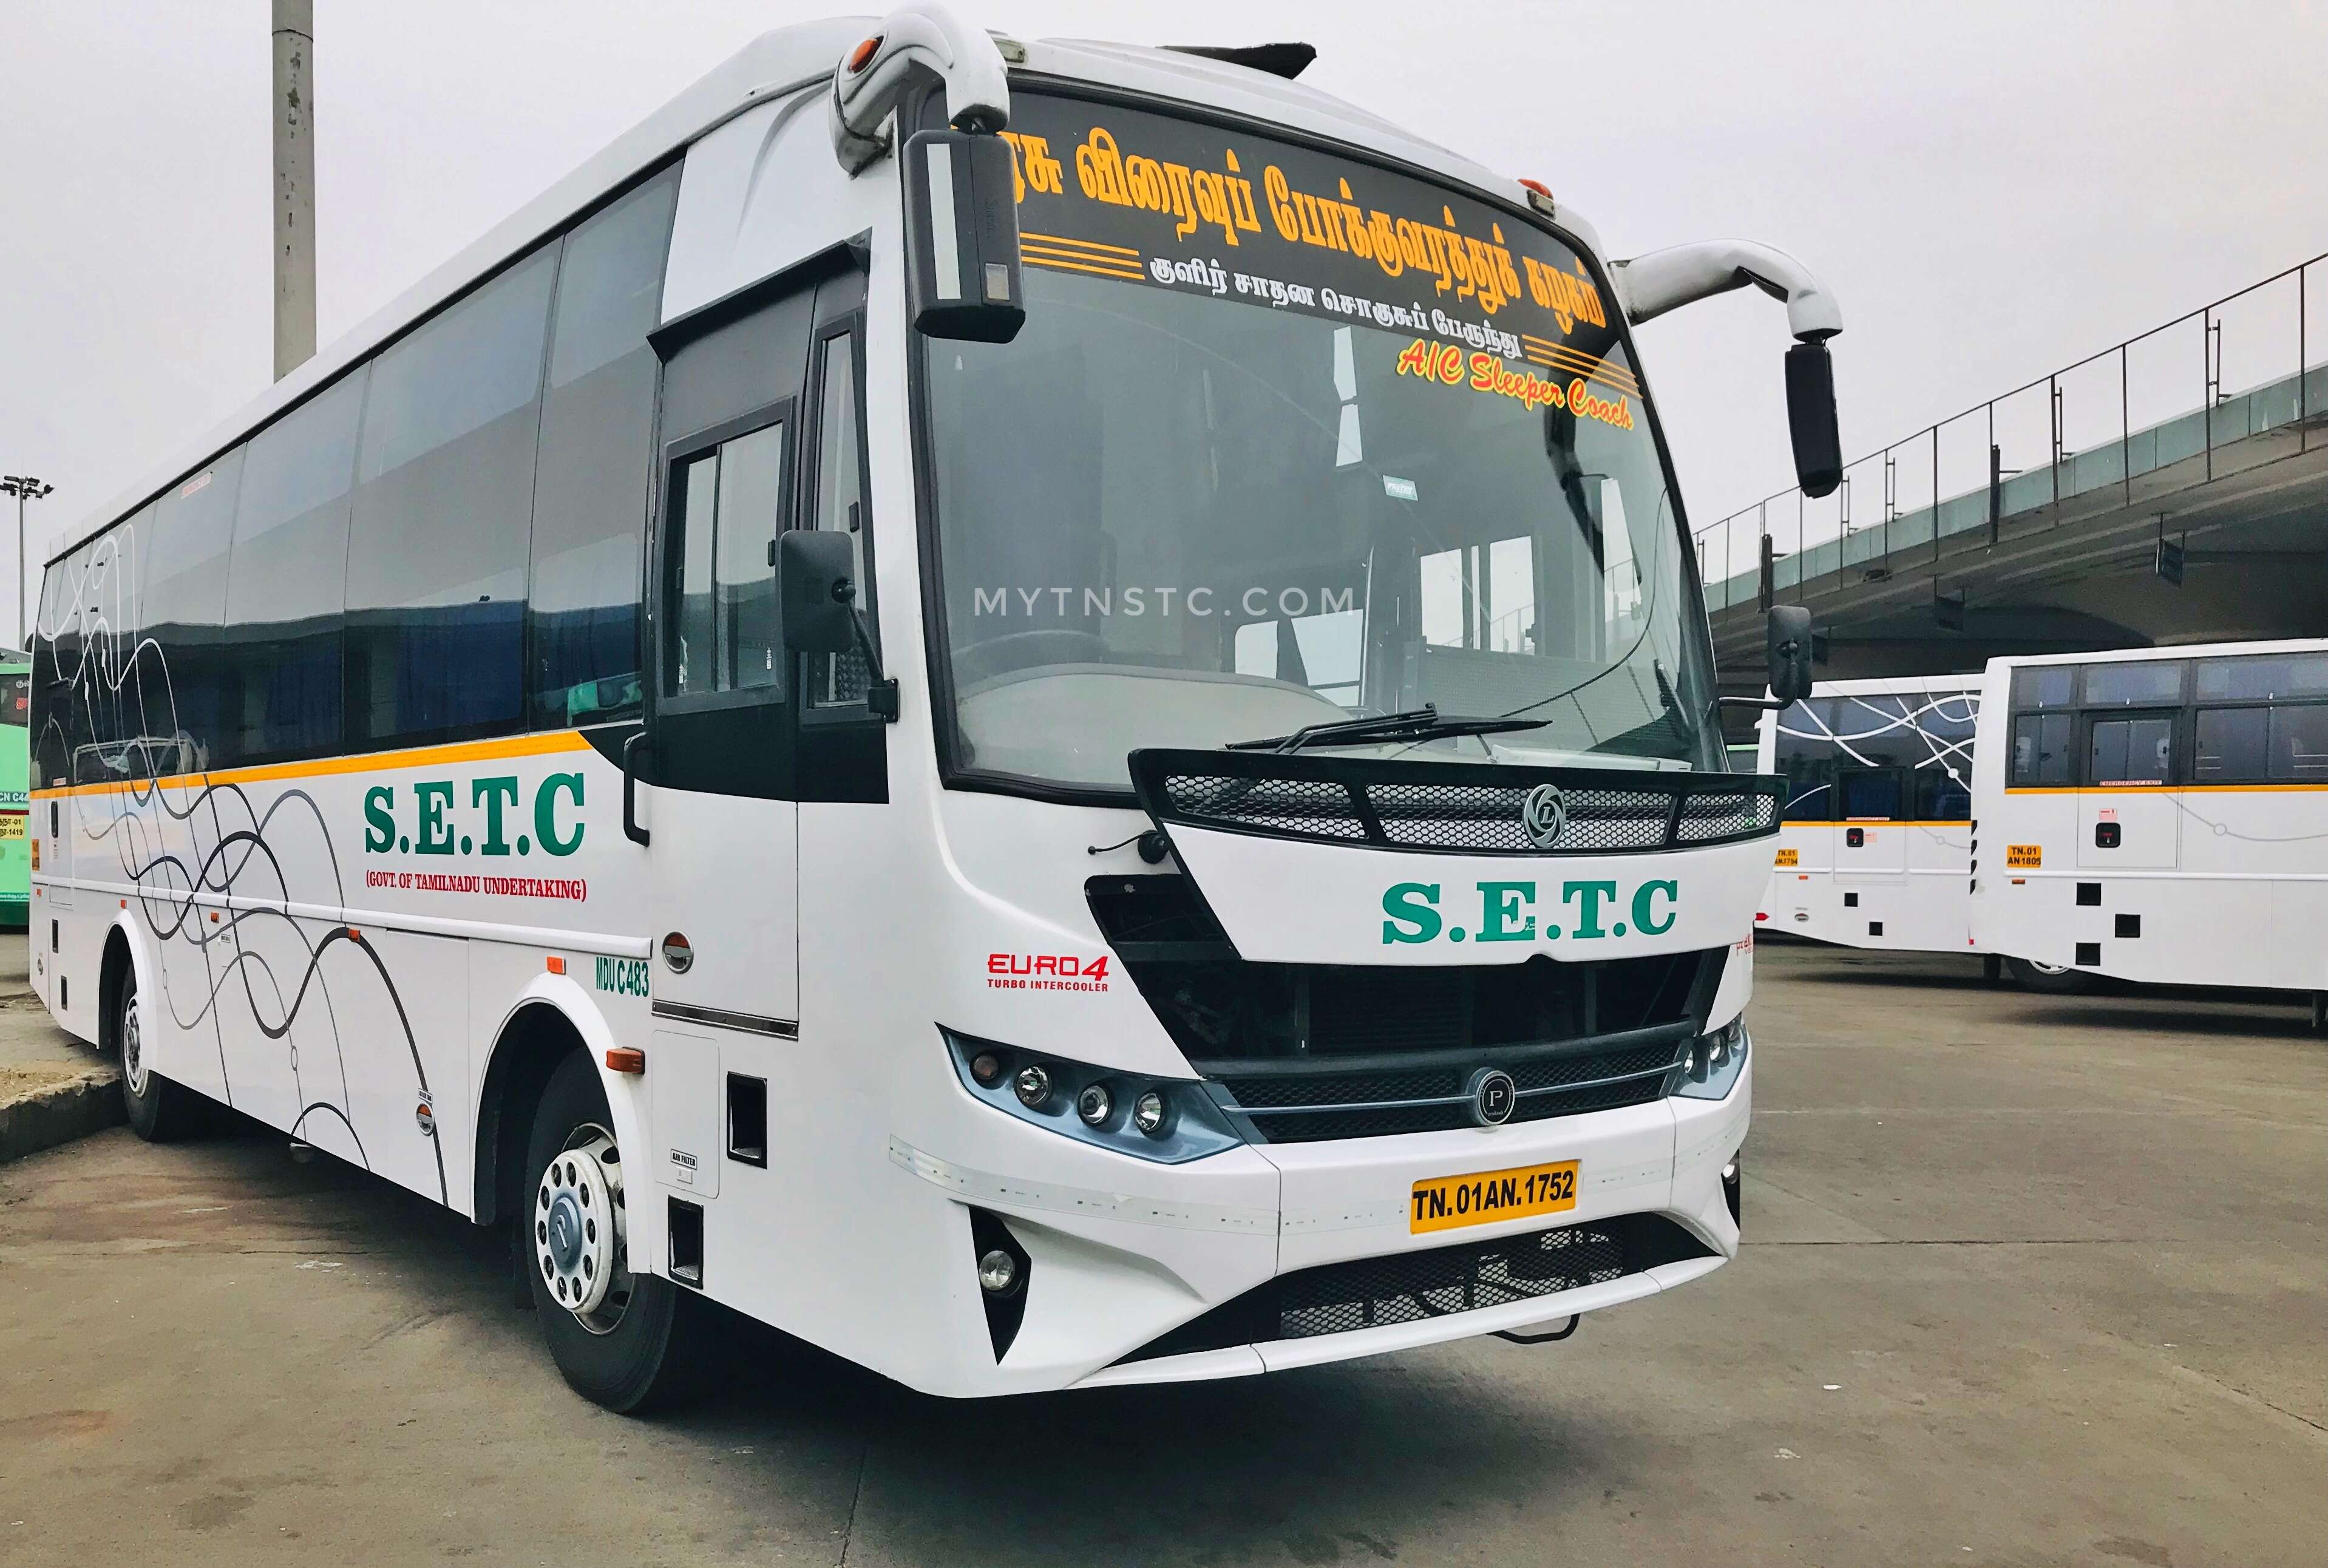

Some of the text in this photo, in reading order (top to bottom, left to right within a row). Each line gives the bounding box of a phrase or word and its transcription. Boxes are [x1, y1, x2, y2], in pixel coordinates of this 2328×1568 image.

[1076, 126, 1261, 246] விரைவுப்
[1264, 165, 1521, 314] போக்குவரத்துக்
[1522, 256, 1606, 334] கழகம்
[1150, 257, 1522, 359] குளிர் சாதன சொகுசுப் பேருந்து
[1397, 338, 1634, 431] A/C Sleeper Coach
[364, 772, 585, 857] S.E.T.C
[366, 869, 586, 903] (GOVT. OF TAMILNADU UNDERTAKING)
[1382, 880, 1678, 945] S.E.T.C
[988, 979, 1108, 992] TURBO INTERCOOLER
[1489, 1090, 1503, 1107] P
[682, 1155, 695, 1166] FILTER
[1413, 1169, 1574, 1221] TN.01AN.1752
